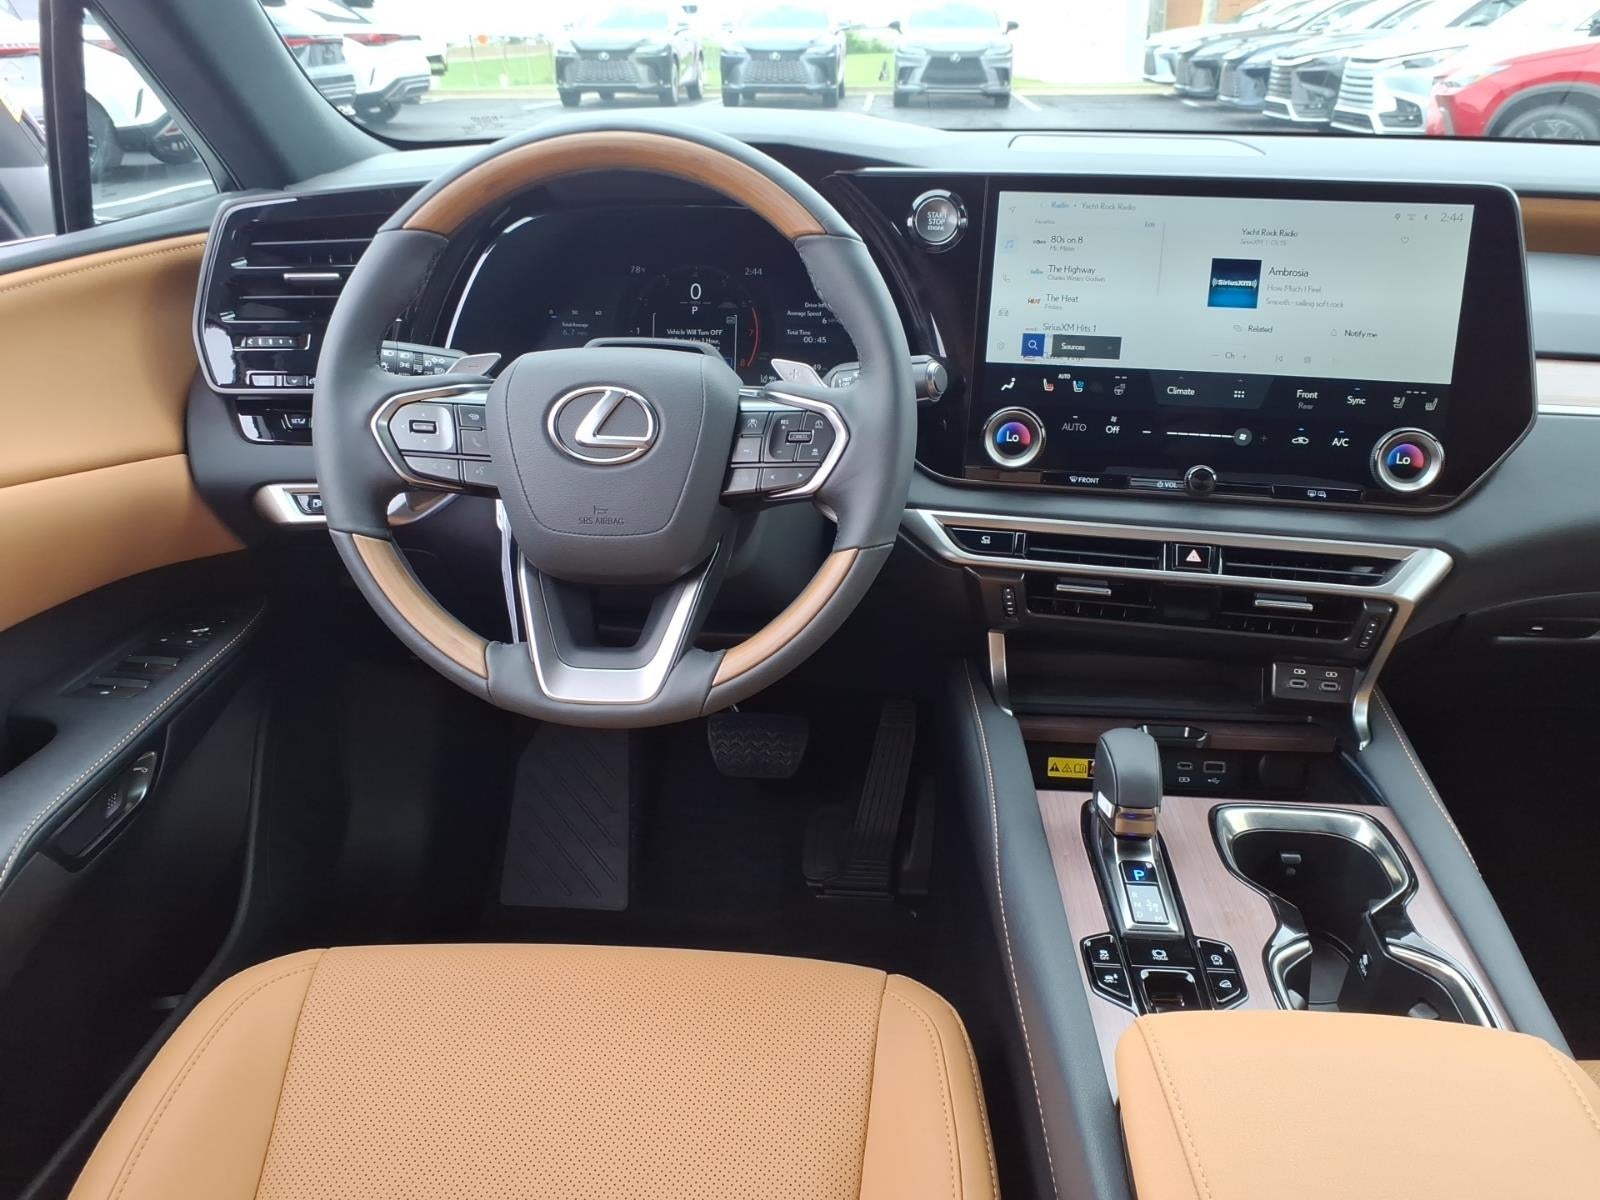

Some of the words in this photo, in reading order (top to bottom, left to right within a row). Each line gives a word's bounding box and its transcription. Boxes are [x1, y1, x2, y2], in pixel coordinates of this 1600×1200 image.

[1081, 202, 1099, 210] Yacht
[1100, 202, 1115, 210] Rock
[1118, 203, 1136, 211] Radio
[1440, 212, 1464, 223] 2:44
[1241, 228, 1260, 236] Yacht
[1261, 228, 1277, 236] Rock
[1279, 229, 1298, 238] Radio
[1050, 235, 1066, 244] 80s
[744, 267, 763, 276] 2:44
[1048, 264, 1063, 273] The
[1063, 265, 1096, 275] Highway
[1268, 267, 1309, 277] Ambrosia
[690, 282, 702, 300] 0
[1046, 293, 1060, 302] The
[1061, 295, 1079, 303] Heat
[691, 306, 699, 315] P
[821, 317, 828, 325] 6
[1042, 322, 1075, 332] SiriusXM
[1076, 324, 1091, 332] Hits
[1247, 325, 1274, 334] Related
[1344, 329, 1367, 339] Notify
[803, 336, 827, 344] 00:45
[1061, 342, 1086, 351] Sources
[1225, 351, 1236, 360] Ch
[1167, 386, 1196, 396] Climate
[1296, 389, 1319, 399] Front
[1346, 395, 1367, 405] Sync
[1061, 422, 1088, 432] AUTO
[1105, 425, 1121, 434] Off
[1006, 430, 1020, 443] Lo
[1331, 437, 1350, 447] A/C
[1395, 453, 1411, 465] Lo
[577, 516, 594, 525] SRS
[594, 517, 625, 526] AIRBAG
[1133, 869, 1145, 881] P
